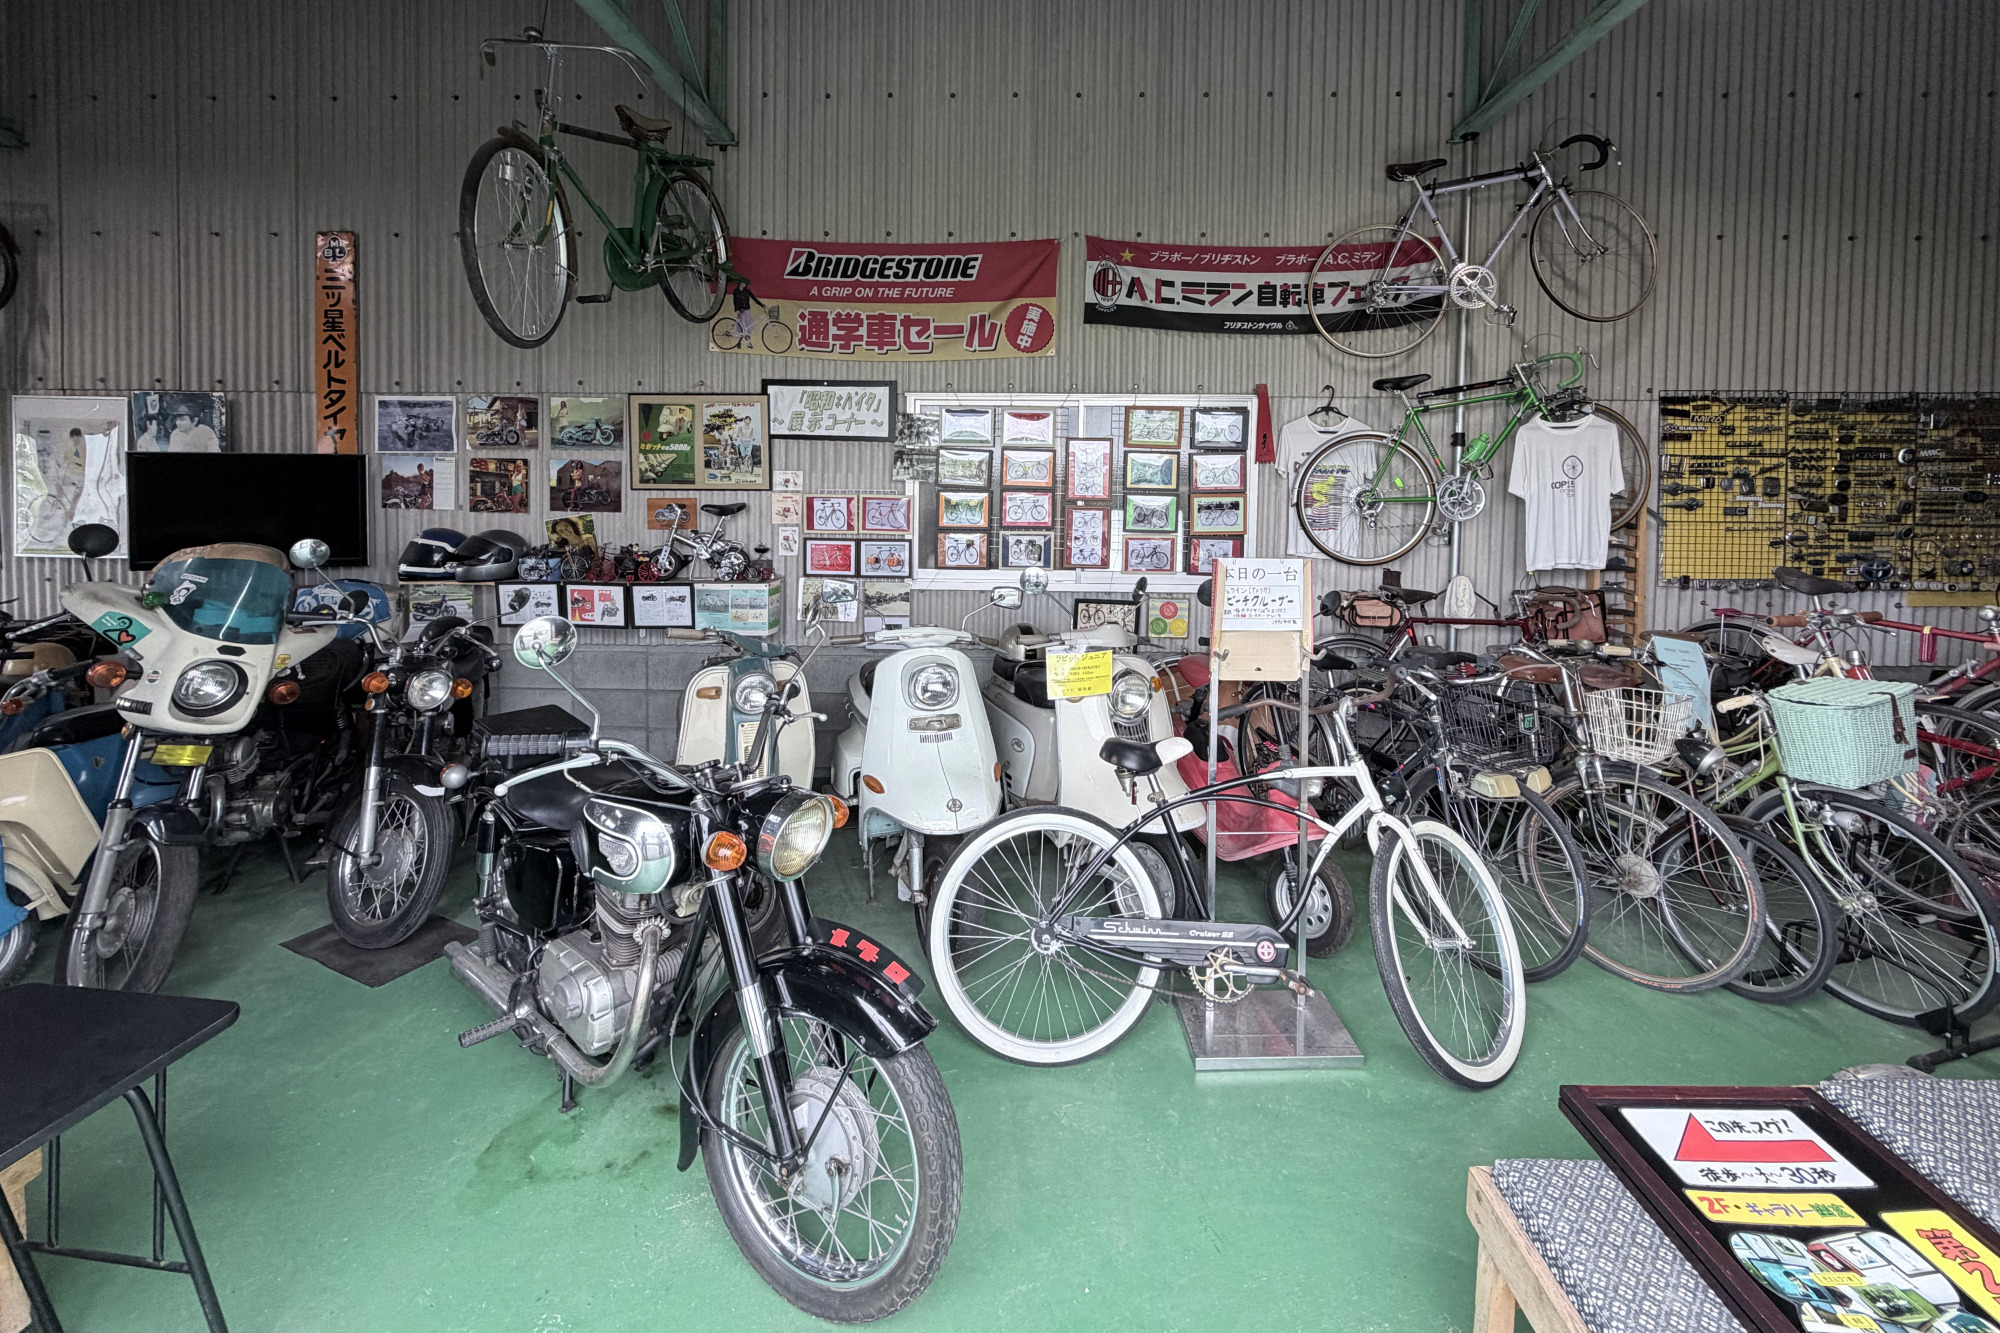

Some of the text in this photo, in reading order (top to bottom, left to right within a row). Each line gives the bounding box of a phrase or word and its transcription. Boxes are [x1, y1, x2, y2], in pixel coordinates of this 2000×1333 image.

[785, 249, 981, 280] BRIDGESTONE
[1200, 253, 1261, 266] ブリヂストン
[809, 286, 956, 299] A GRIP ON THE FUTURE
[797, 309, 1001, 354] 通学車セール
[1016, 305, 1043, 349] 実施中
[322, 268, 346, 454] 三ツ星ベルトタイヤ
[1693, 415, 1723, 423] MIRA
[1225, 566, 1298, 582] 本日の一台
[1227, 594, 1294, 607] ビーチクルーザー
[1081, 652, 1107, 661] ジュニア
[1090, 921, 1179, 936] Schwinn
[1189, 929, 1221, 938] Cruiser
